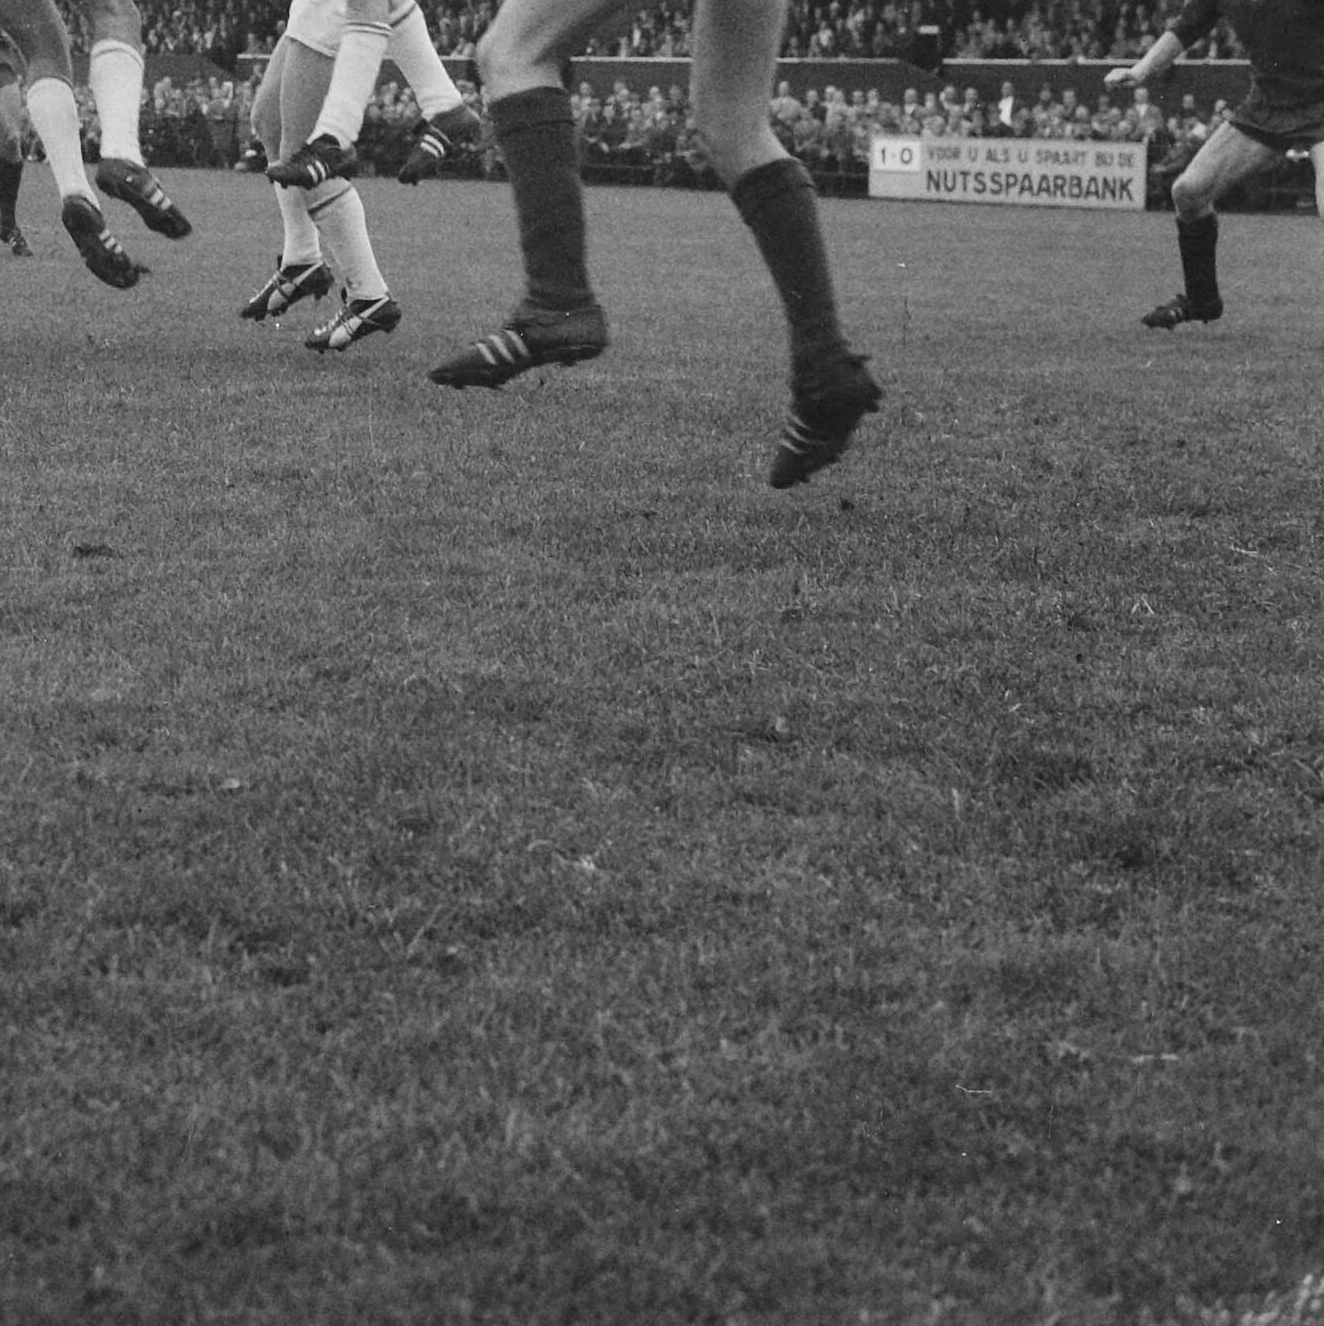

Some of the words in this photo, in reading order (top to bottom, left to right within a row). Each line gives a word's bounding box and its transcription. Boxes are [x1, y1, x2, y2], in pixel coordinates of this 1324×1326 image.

[967, 146, 978, 163] U
[986, 147, 1010, 164] ALS
[1017, 149, 1028, 164] U
[926, 170, 1134, 201] NUTSSPAARBANK
